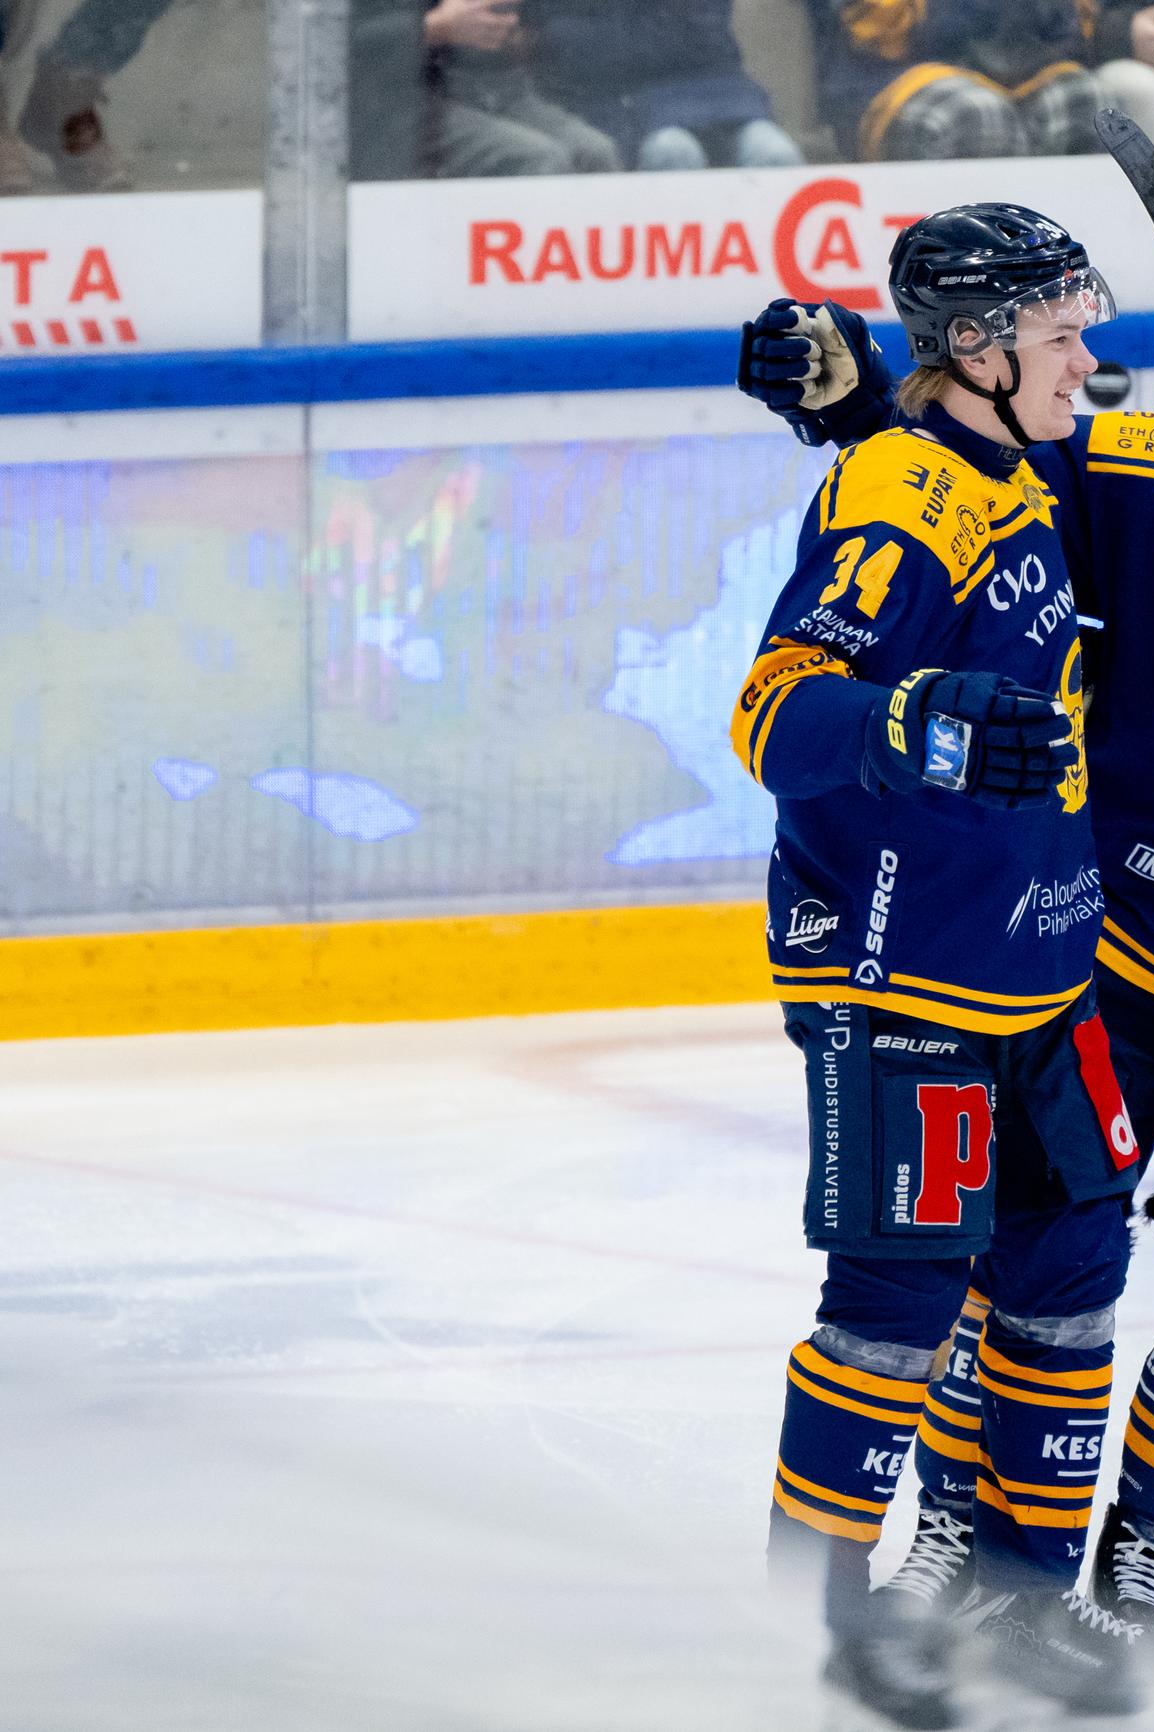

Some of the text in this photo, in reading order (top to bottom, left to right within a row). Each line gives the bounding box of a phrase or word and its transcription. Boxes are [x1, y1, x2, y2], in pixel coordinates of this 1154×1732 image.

[938, 274, 988, 287] BAUER
[1119, 426, 1147, 438] ETH
[818, 535, 905, 620] 34
[888, 667, 946, 754] BAU
[864, 848, 899, 956] SERCO
[785, 907, 840, 947] Liiga
[872, 1034, 960, 1055] BAUER
[891, 1163, 911, 1225] pintos
[1042, 1433, 1105, 1461] KES
